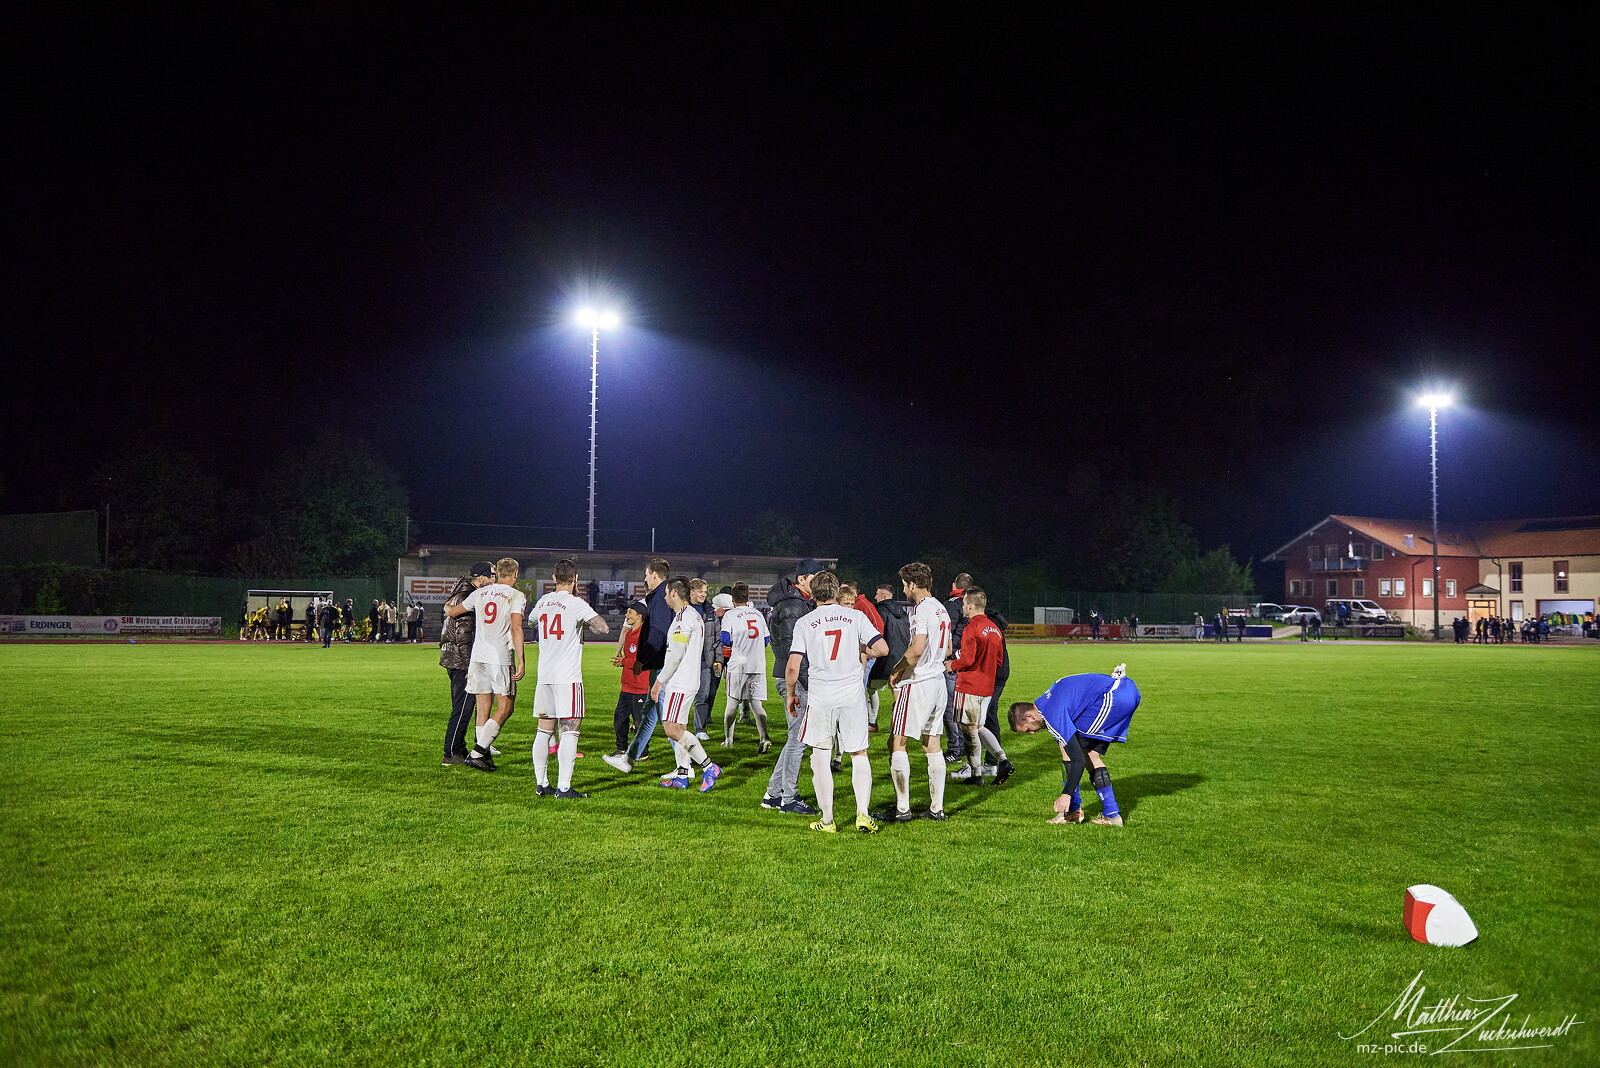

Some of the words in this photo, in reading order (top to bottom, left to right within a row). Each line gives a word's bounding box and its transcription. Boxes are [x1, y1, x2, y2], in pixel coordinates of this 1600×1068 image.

[484, 601, 498, 624] 9
[810, 618, 822, 629] SV
[824, 615, 853, 624] Laufen
[30, 620, 72, 630] ERDINGER
[539, 613, 565, 640] 14
[746, 619, 760, 639] 5
[825, 629, 842, 661] 7
